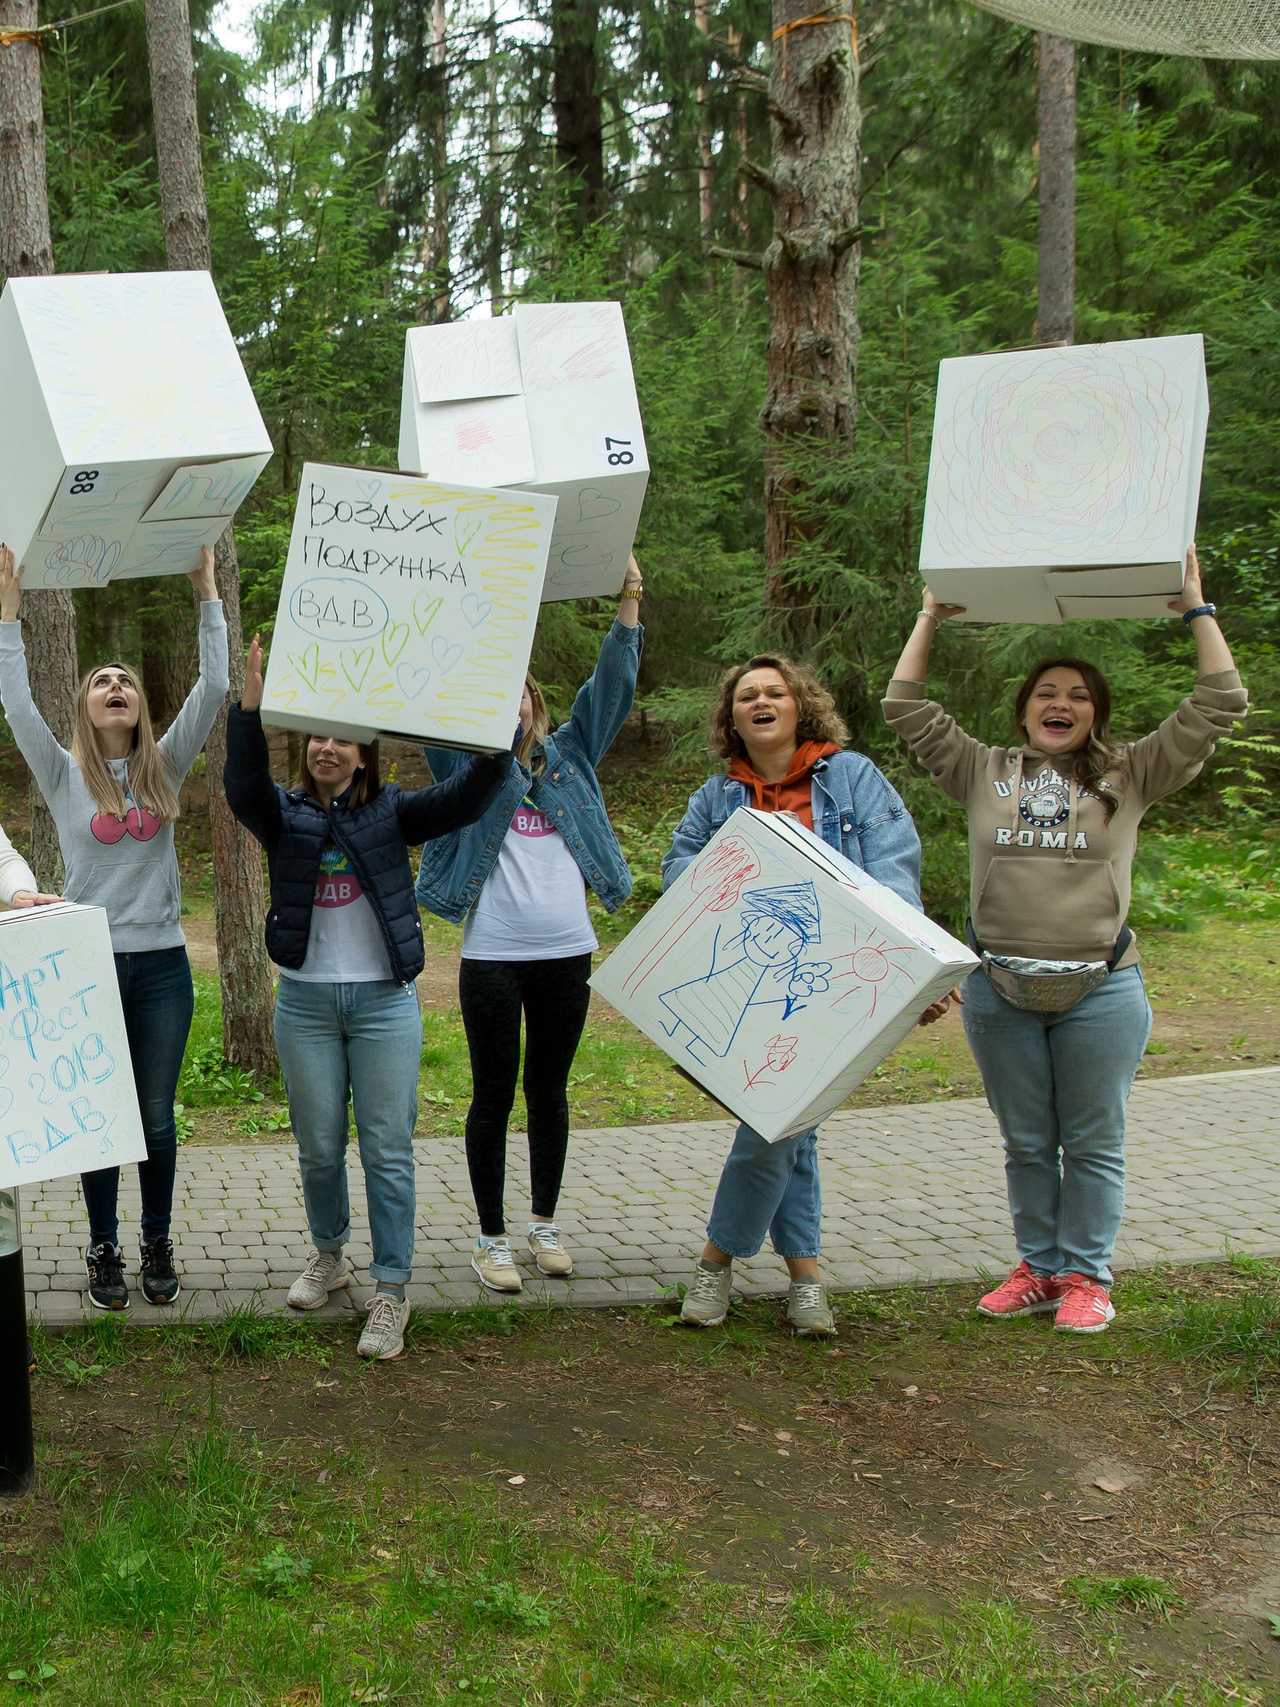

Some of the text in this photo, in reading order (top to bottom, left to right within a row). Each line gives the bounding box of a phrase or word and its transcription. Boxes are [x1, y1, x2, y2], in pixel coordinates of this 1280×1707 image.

[604, 436, 633, 466] 87
[69, 469, 100, 496] 88
[298, 589, 374, 628] ВДВ
[995, 827, 1089, 850] ROMA
[28, 1032, 117, 1105] 2019
[5, 1095, 107, 1168] ВДВ
